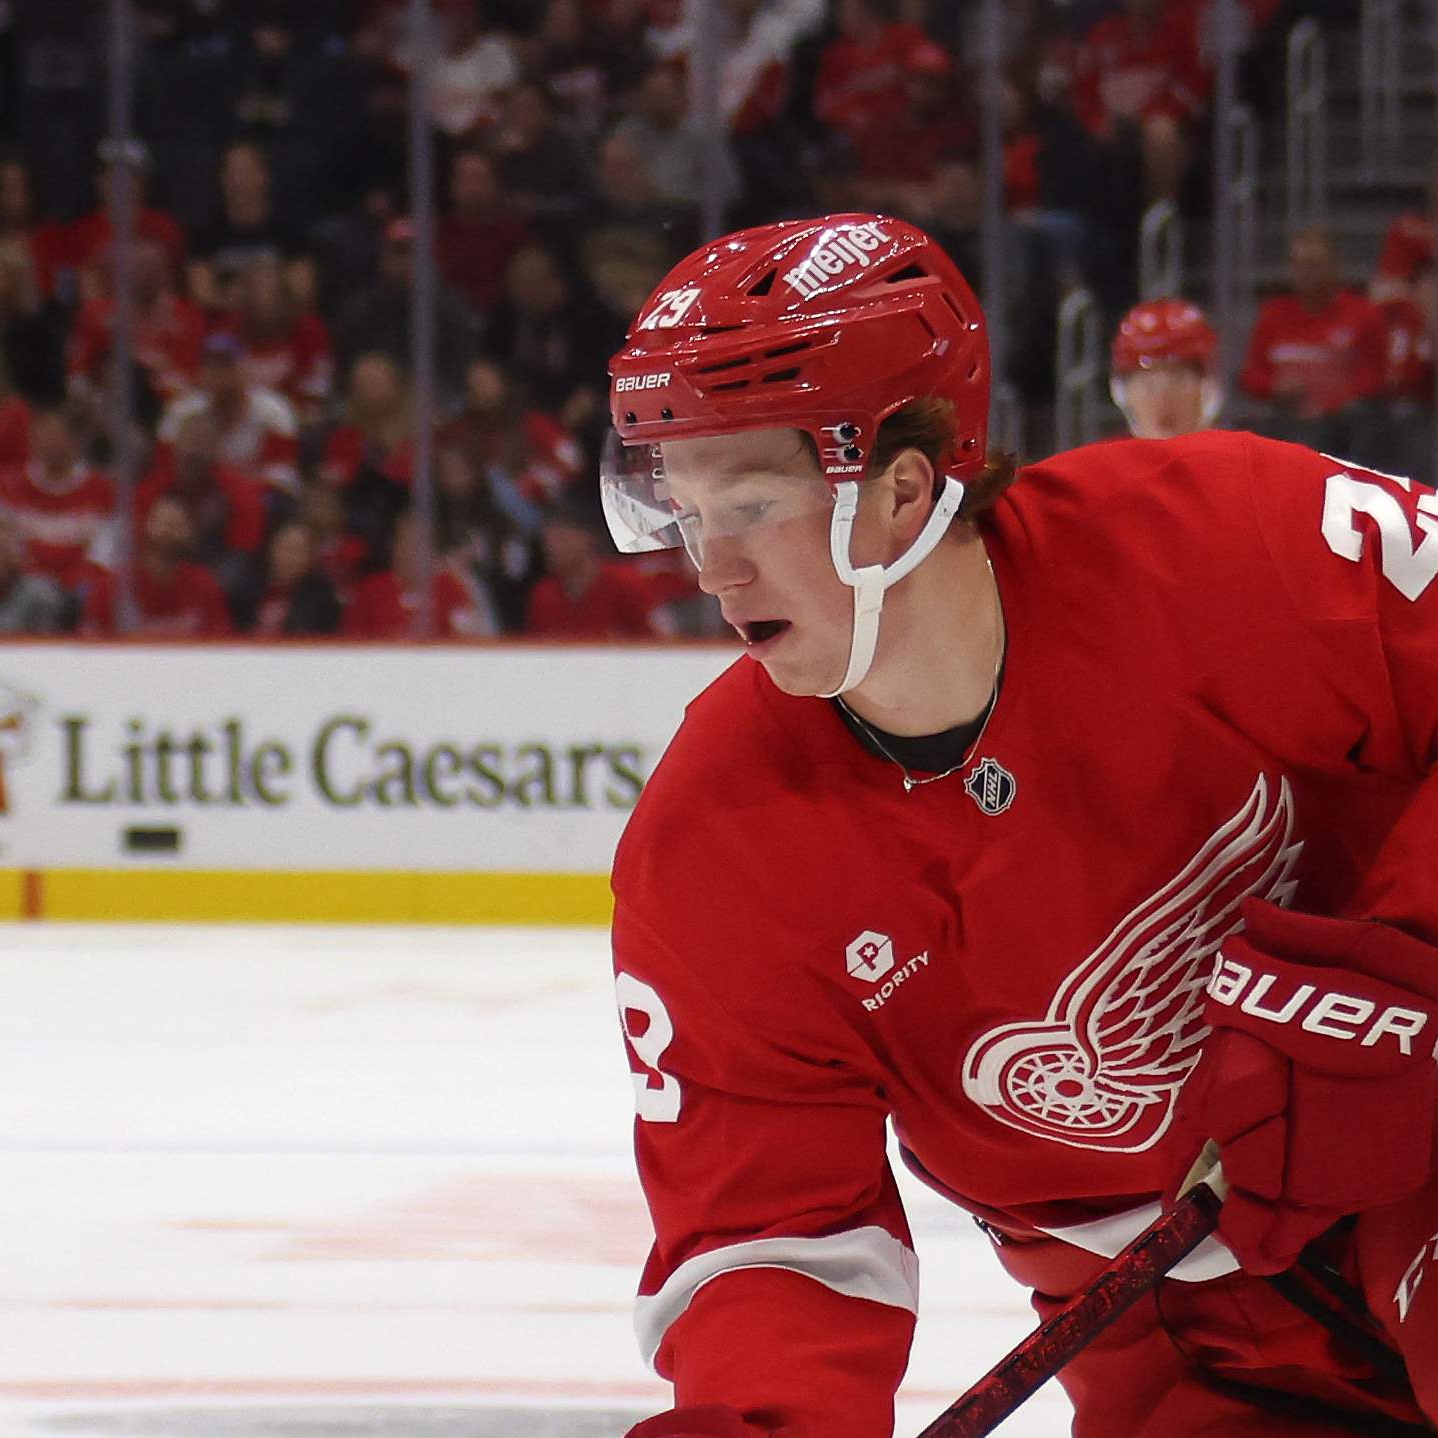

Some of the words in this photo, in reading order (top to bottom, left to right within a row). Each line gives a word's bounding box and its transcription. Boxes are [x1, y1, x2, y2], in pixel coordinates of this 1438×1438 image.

[782, 222, 892, 298] meijer
[638, 288, 701, 330] 29
[59, 715, 292, 806] Little
[311, 713, 644, 809] Caesars
[861, 950, 930, 1012] RIORITY
[1206, 950, 1428, 1056] AUER
